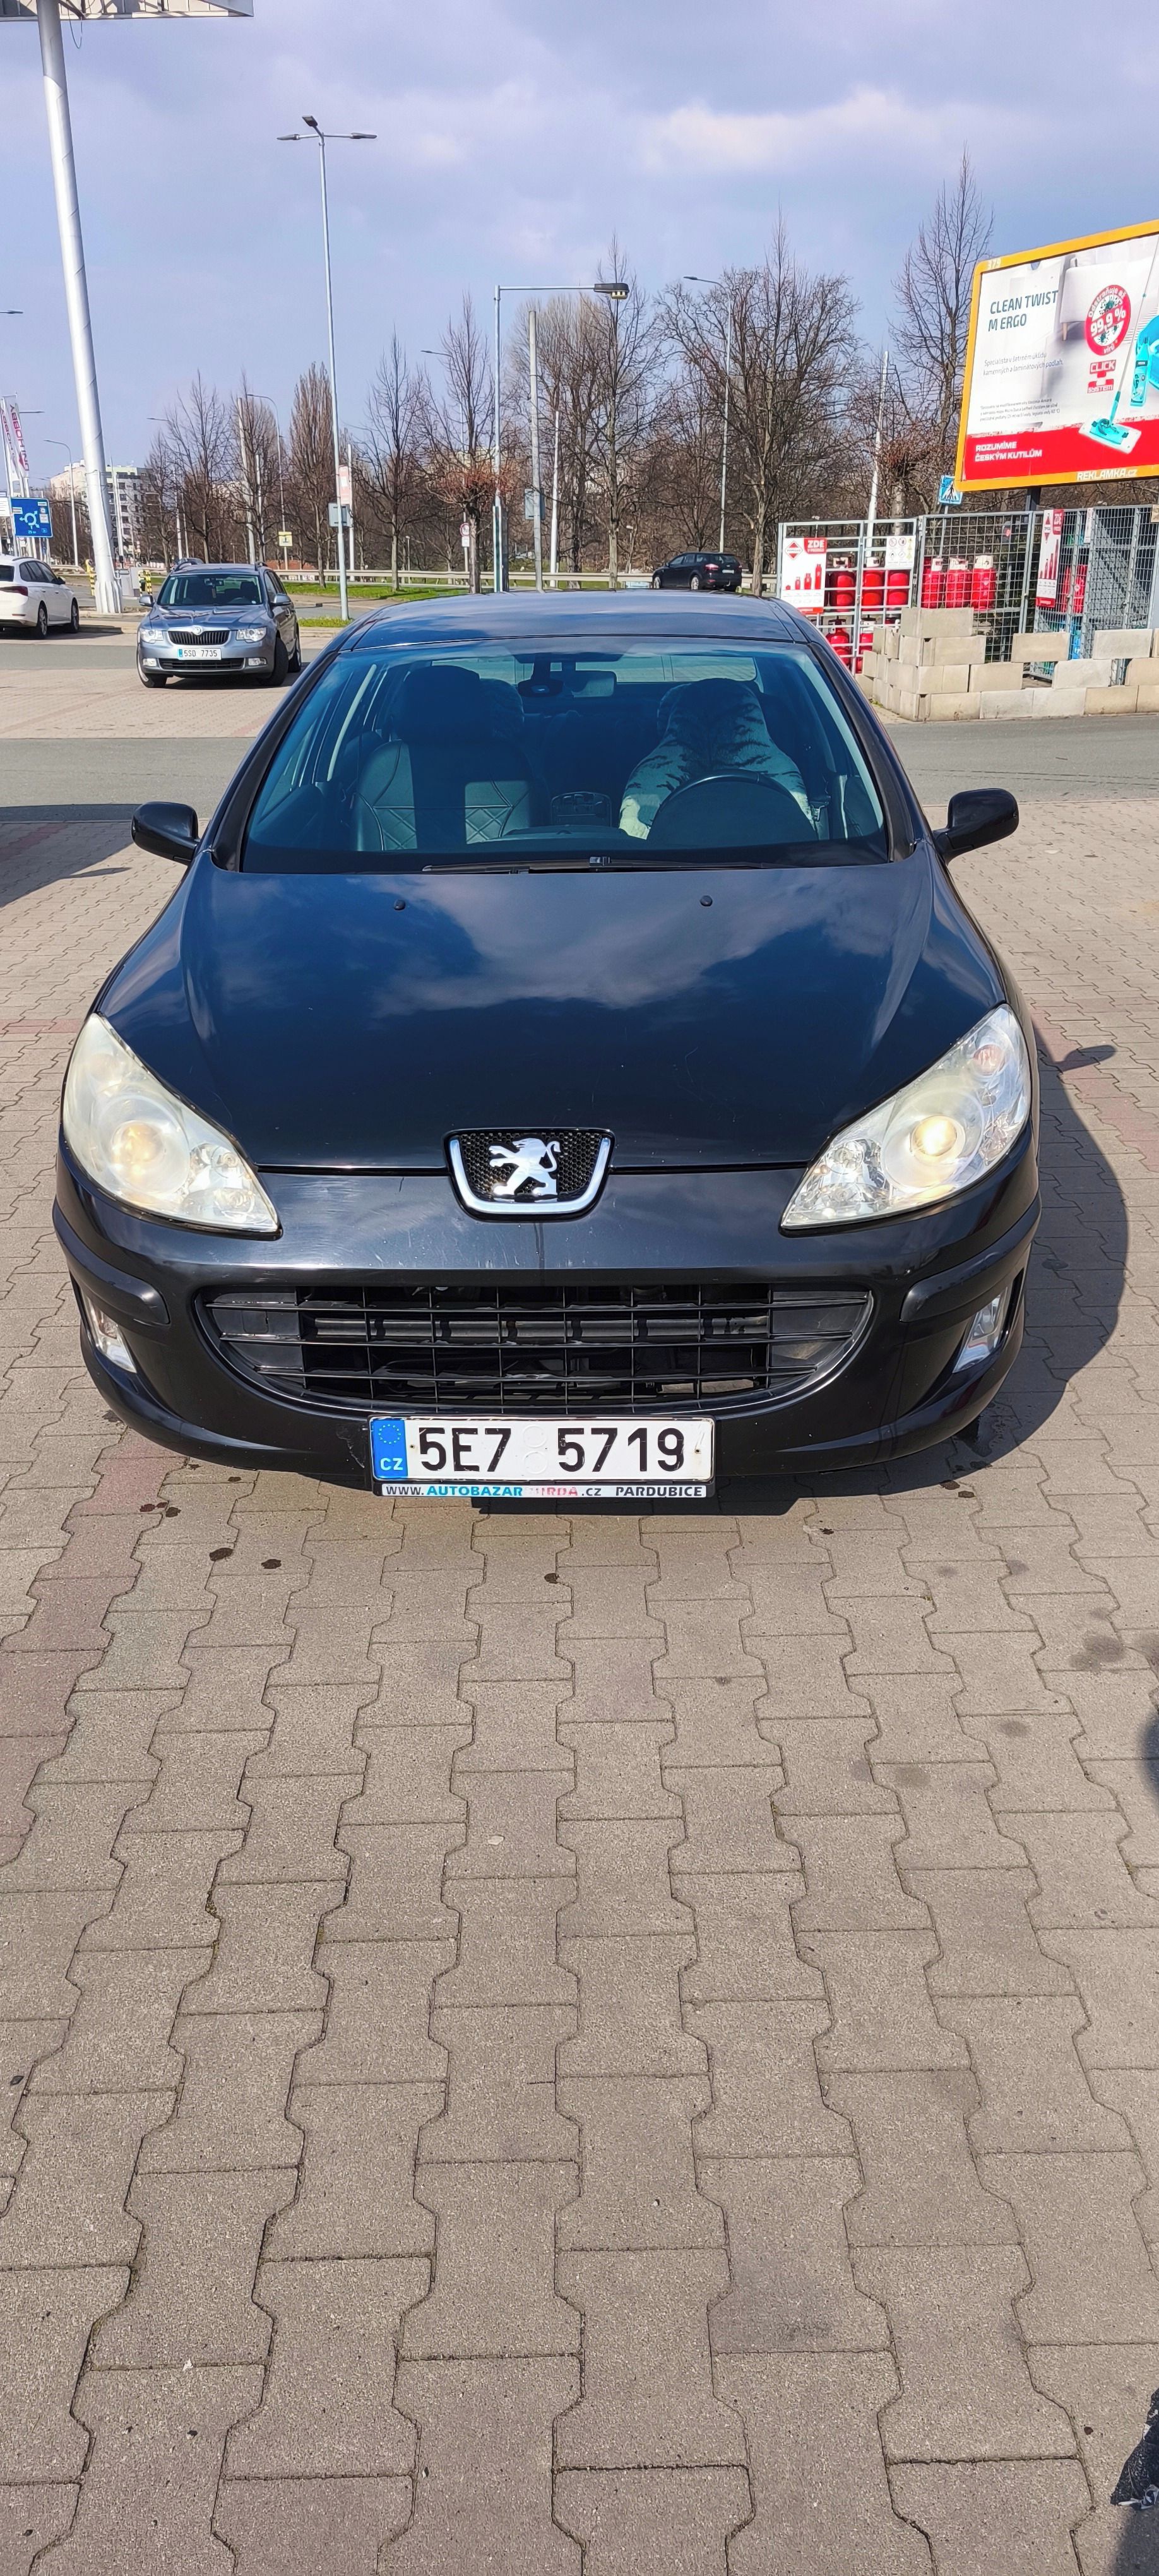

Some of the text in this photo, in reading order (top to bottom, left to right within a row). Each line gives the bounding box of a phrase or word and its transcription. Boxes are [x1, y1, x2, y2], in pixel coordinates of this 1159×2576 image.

[990, 290, 1059, 314] CLEAN TWIST
[988, 314, 1026, 331] M ERGO
[1091, 307, 1126, 337] 99,9 %
[1090, 361, 1115, 373] CLICK
[1088, 385, 1113, 393] SYSTEM
[975, 441, 1017, 452] ROZUMÍME
[975, 448, 1042, 462] ČESKÝM KUTILŮM
[1076, 468, 1138, 480] REKLAMKA.cz
[807, 540, 824, 548] ZDE
[380, 1427, 685, 1472] CZ 5E7 5719
[615, 1486, 703, 1497] PARDUBICE
